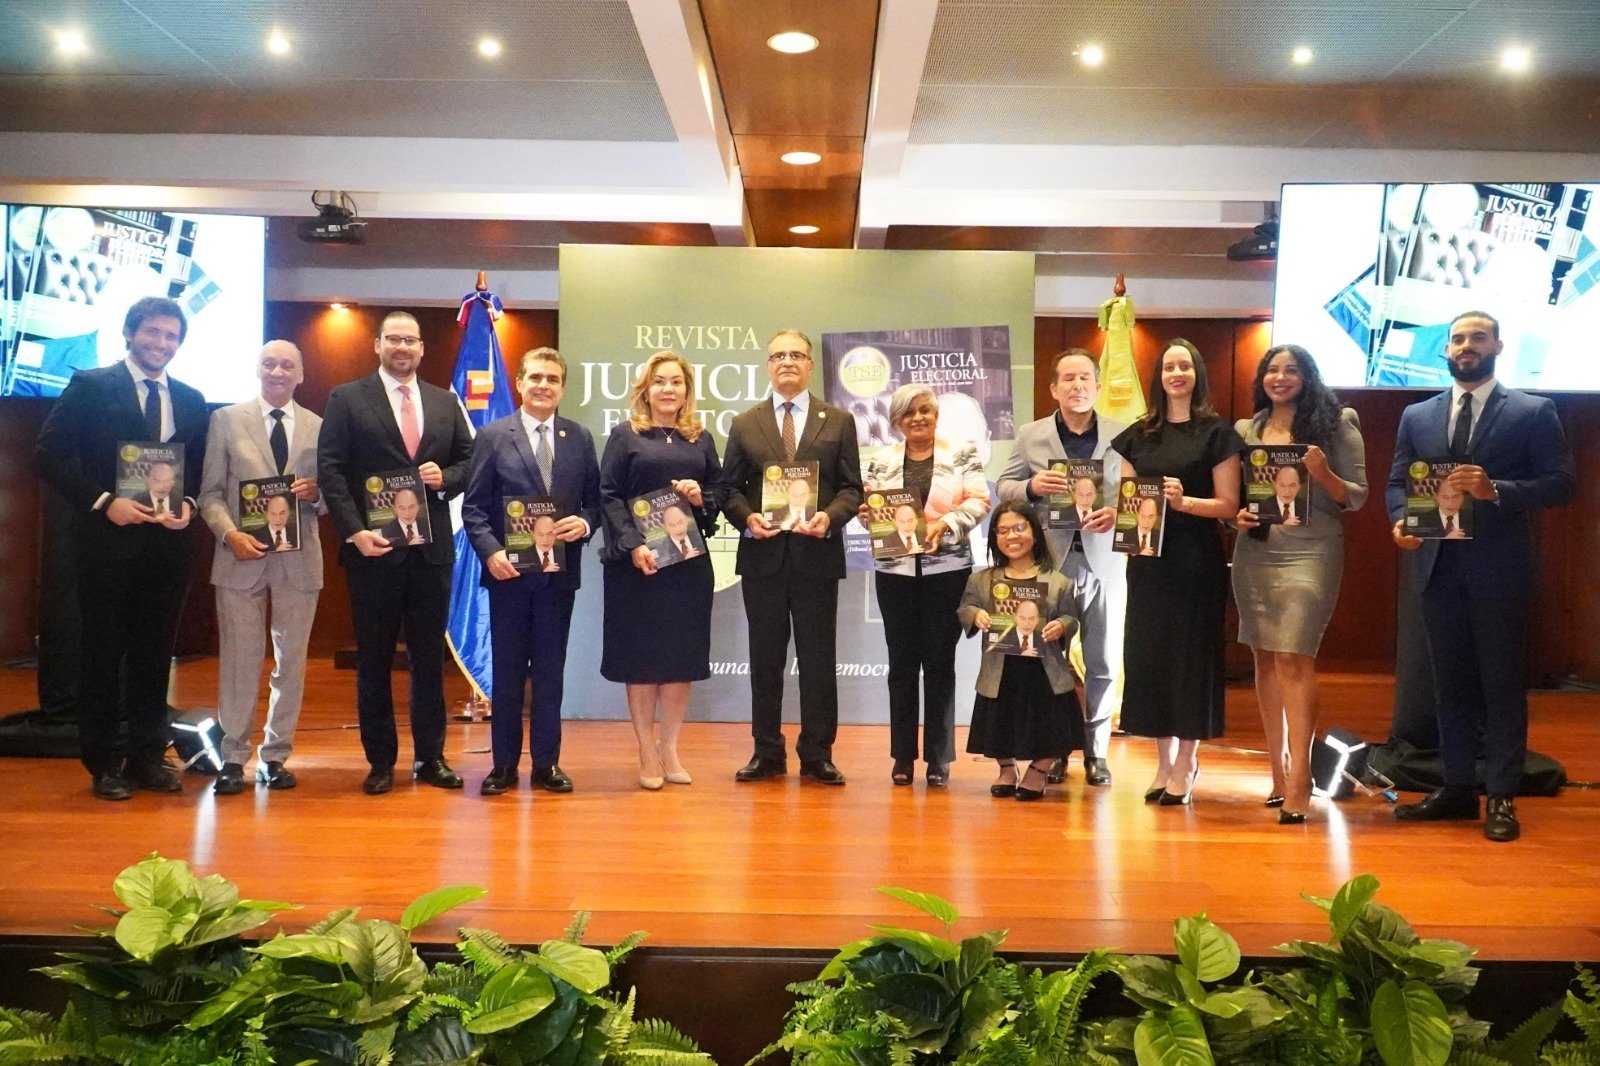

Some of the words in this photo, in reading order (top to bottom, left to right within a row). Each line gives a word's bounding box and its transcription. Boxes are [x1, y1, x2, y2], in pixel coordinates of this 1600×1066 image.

[634, 325, 761, 350] REVISTA
[900, 352, 978, 372] JUSTICIA
[911, 367, 988, 383] ELECTORAL
[579, 362, 773, 407] JUICI
[261, 482, 287, 491] JUSTICIA
[386, 475, 413, 484] JUSTICIA
[651, 492, 677, 505] JUSTICIA
[527, 502, 554, 510] JUSTICIA
[835, 663, 889, 677] emocr
